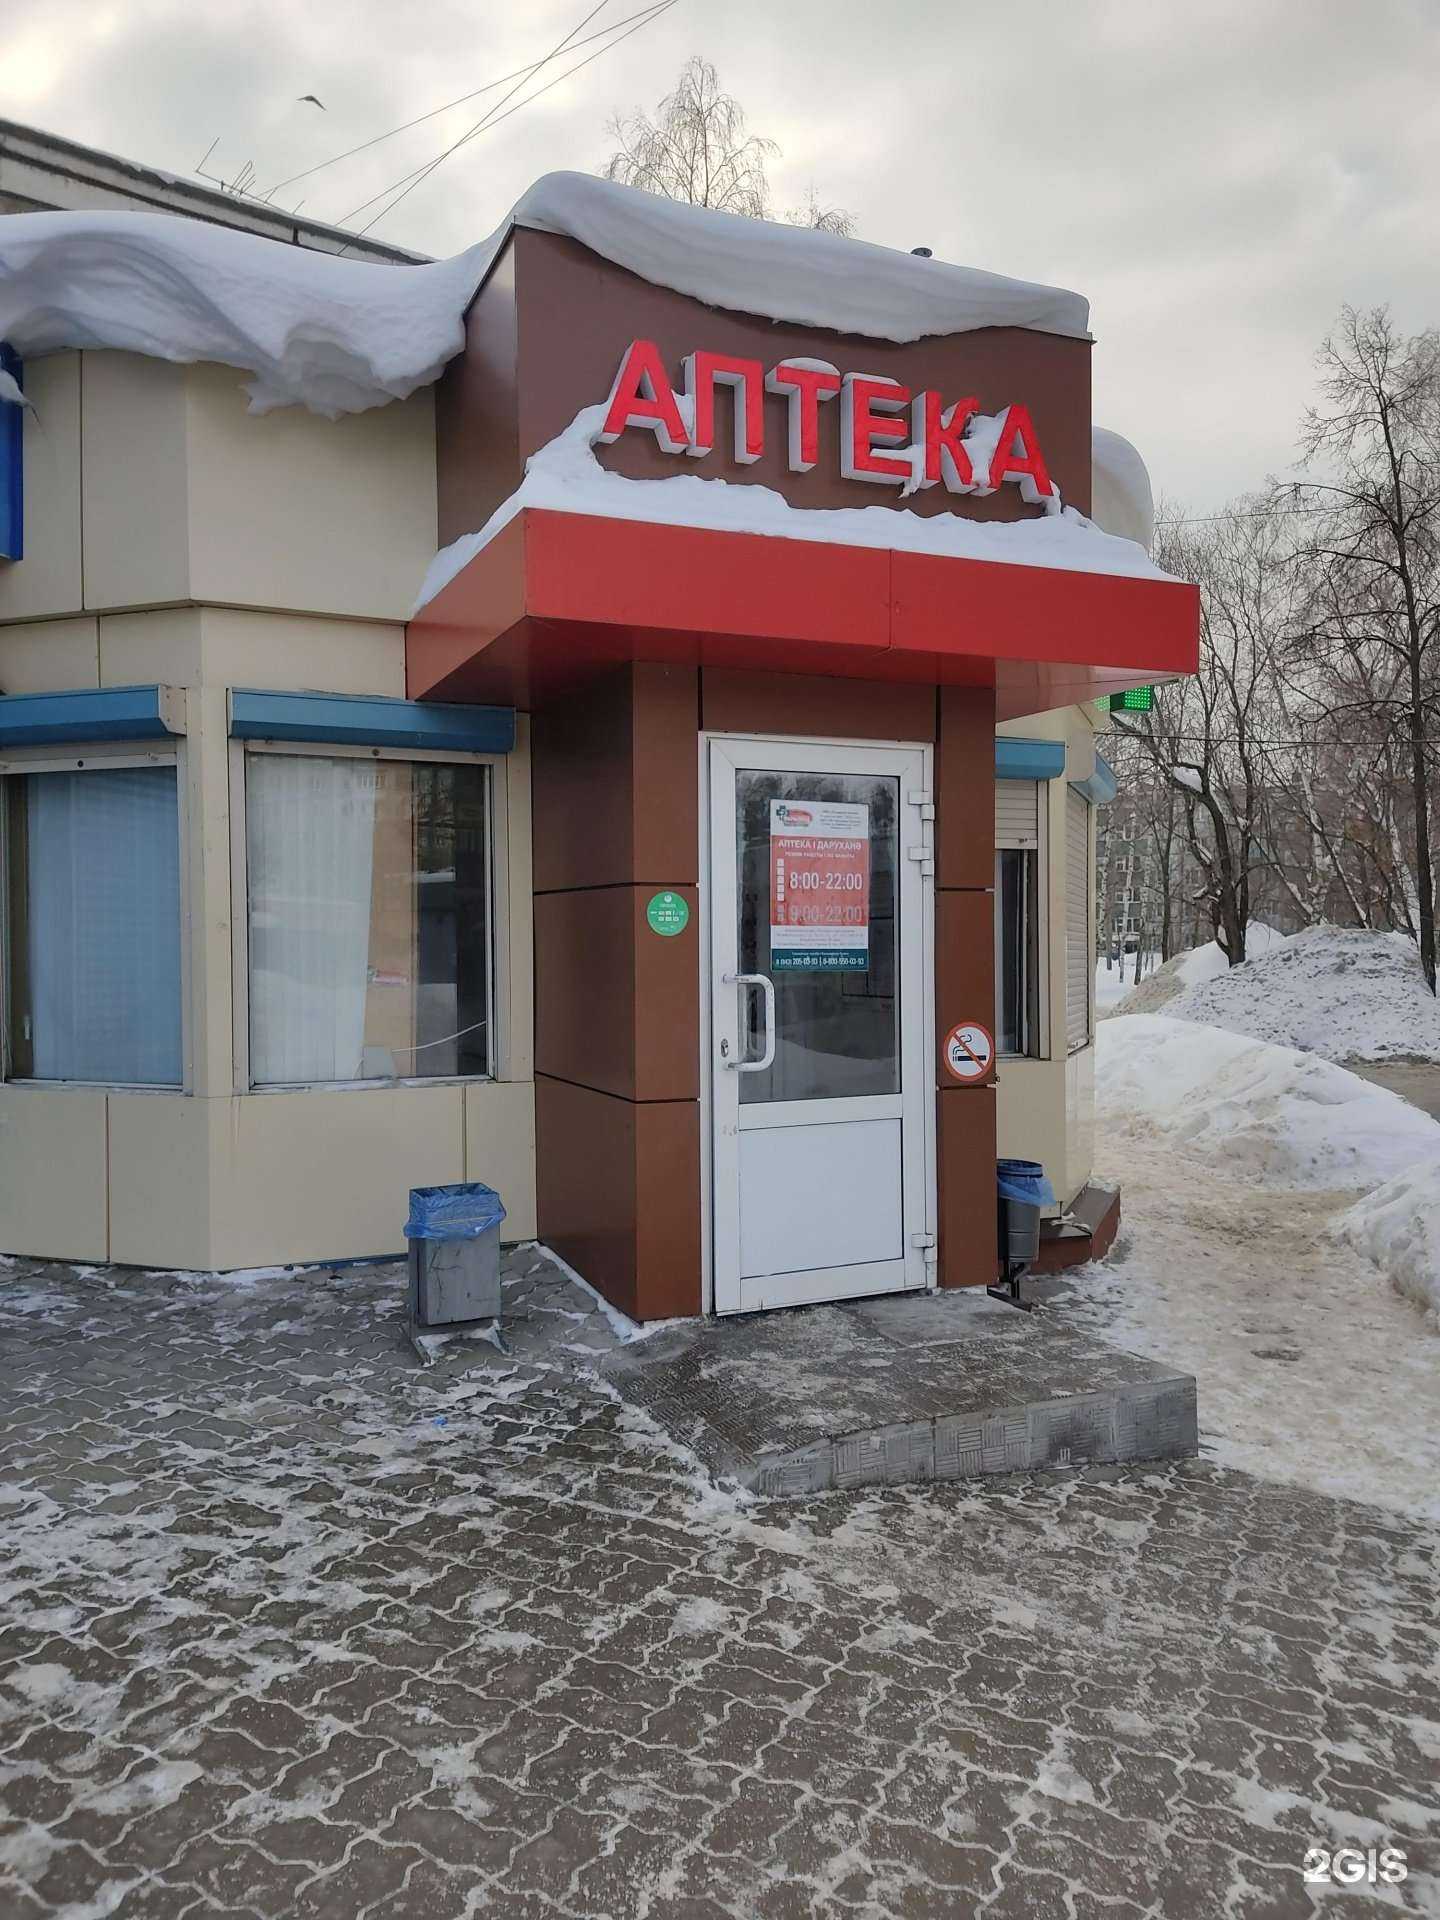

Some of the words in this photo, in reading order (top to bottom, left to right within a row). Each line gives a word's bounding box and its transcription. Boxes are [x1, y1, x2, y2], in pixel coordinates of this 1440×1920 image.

[601, 340, 1055, 500] АПТЕКА
[778, 840, 811, 849] АПТЕКА
[790, 872, 863, 890] 8:00-22:00
